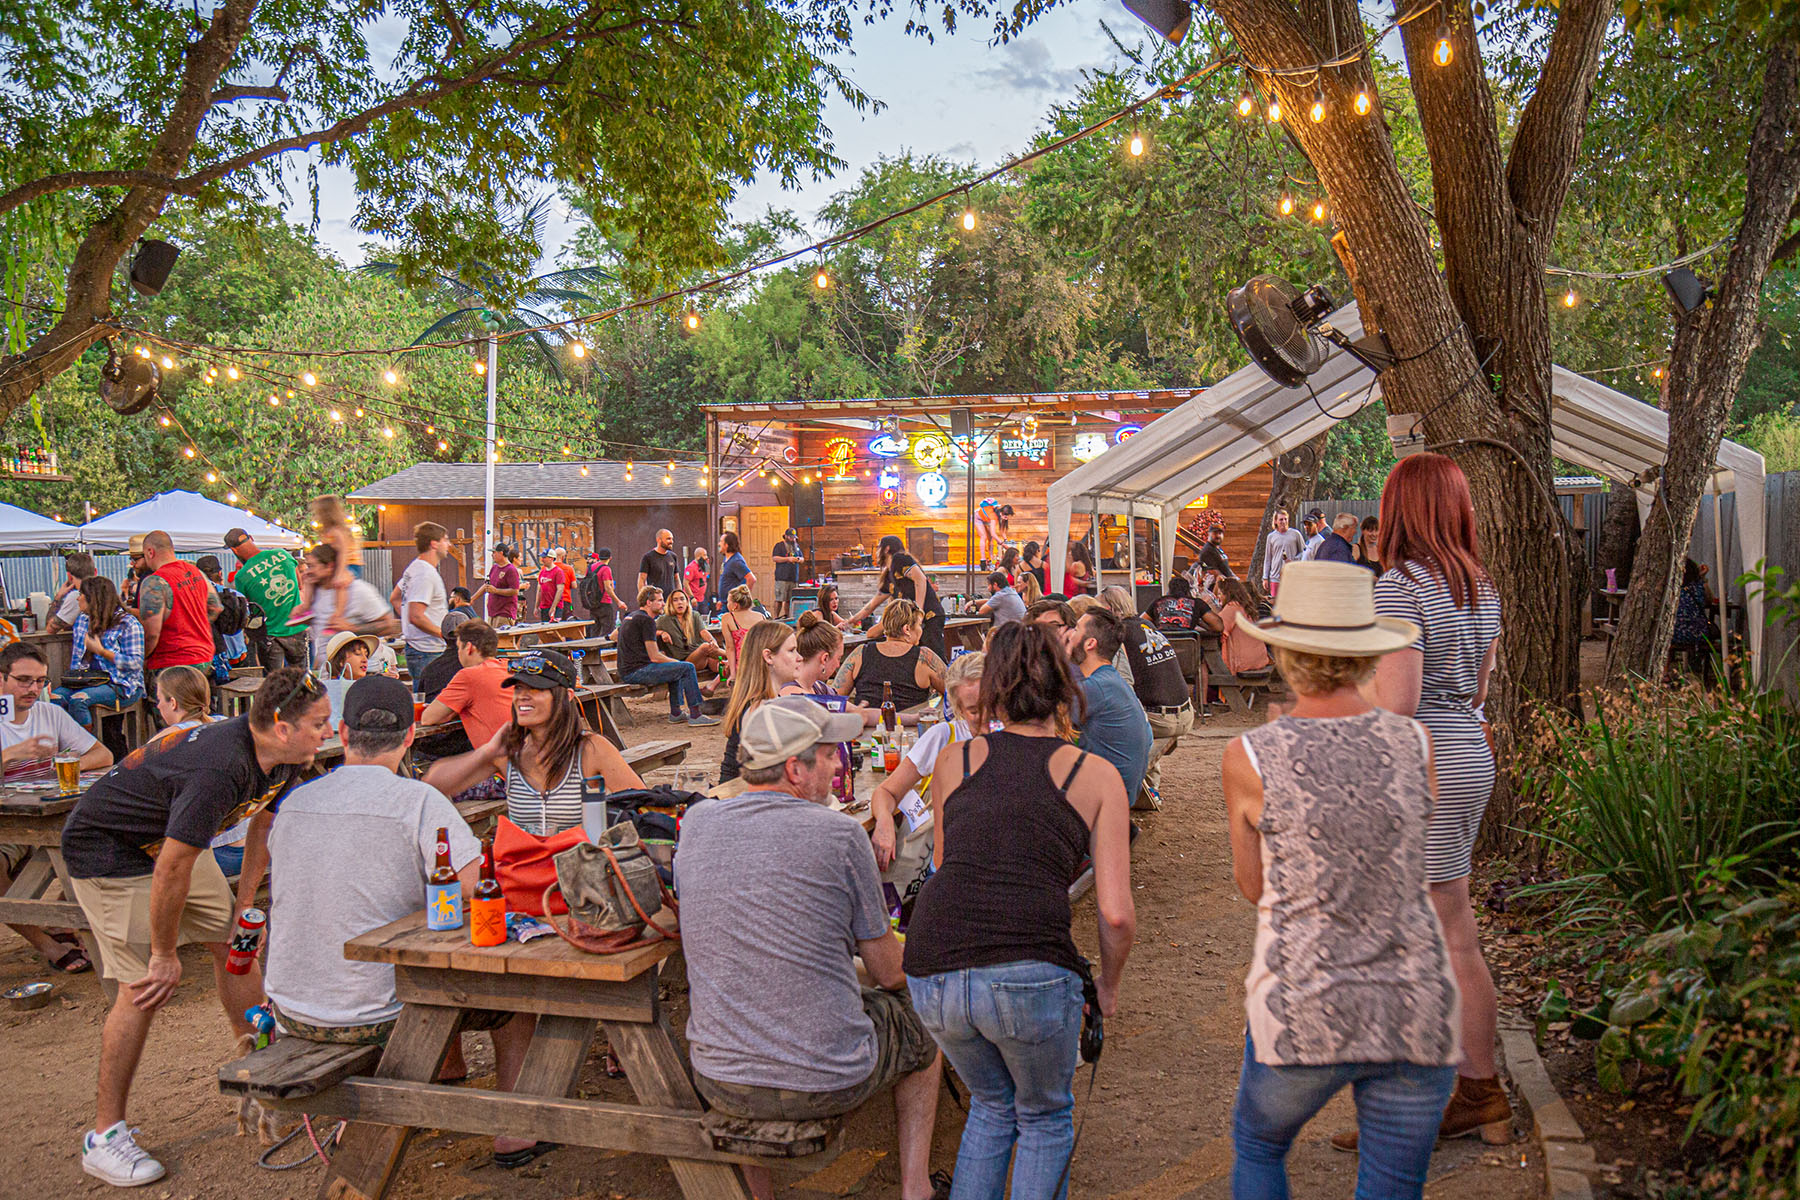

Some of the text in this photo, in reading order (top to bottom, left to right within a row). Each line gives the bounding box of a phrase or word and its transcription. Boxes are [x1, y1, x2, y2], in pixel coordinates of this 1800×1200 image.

[1002, 438, 1049, 449] DEEP EDDY
[247, 552, 287, 578] TEXAS
[1145, 652, 1164, 663] BAD
